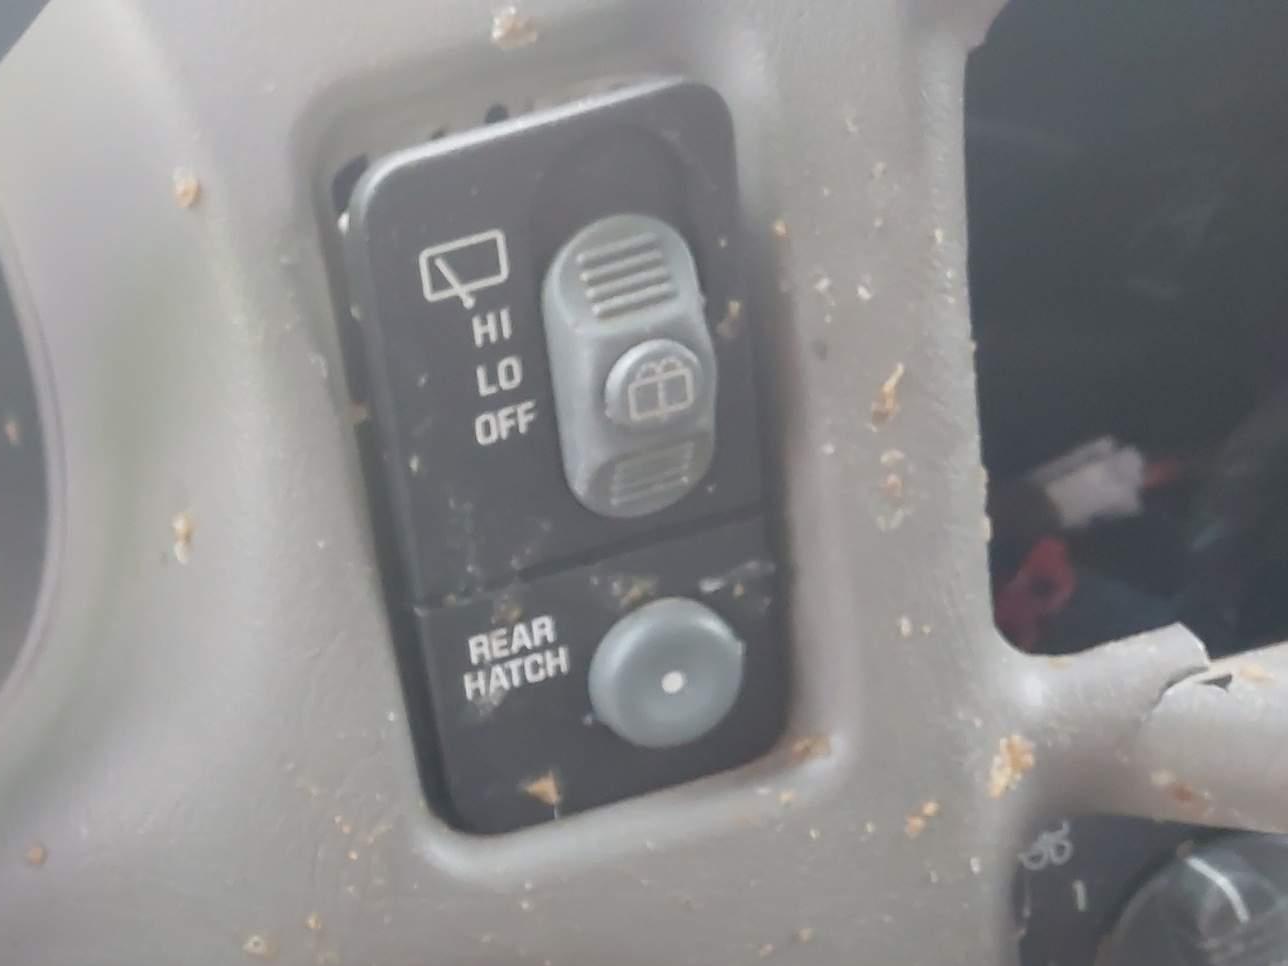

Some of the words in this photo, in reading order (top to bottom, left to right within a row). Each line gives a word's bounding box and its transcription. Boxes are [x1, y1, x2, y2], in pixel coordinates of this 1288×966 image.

[472, 309, 513, 347] HI
[477, 356, 524, 397] LO
[475, 401, 537, 445] OFF
[468, 615, 556, 664] REAR
[463, 646, 570, 699] HATCH
